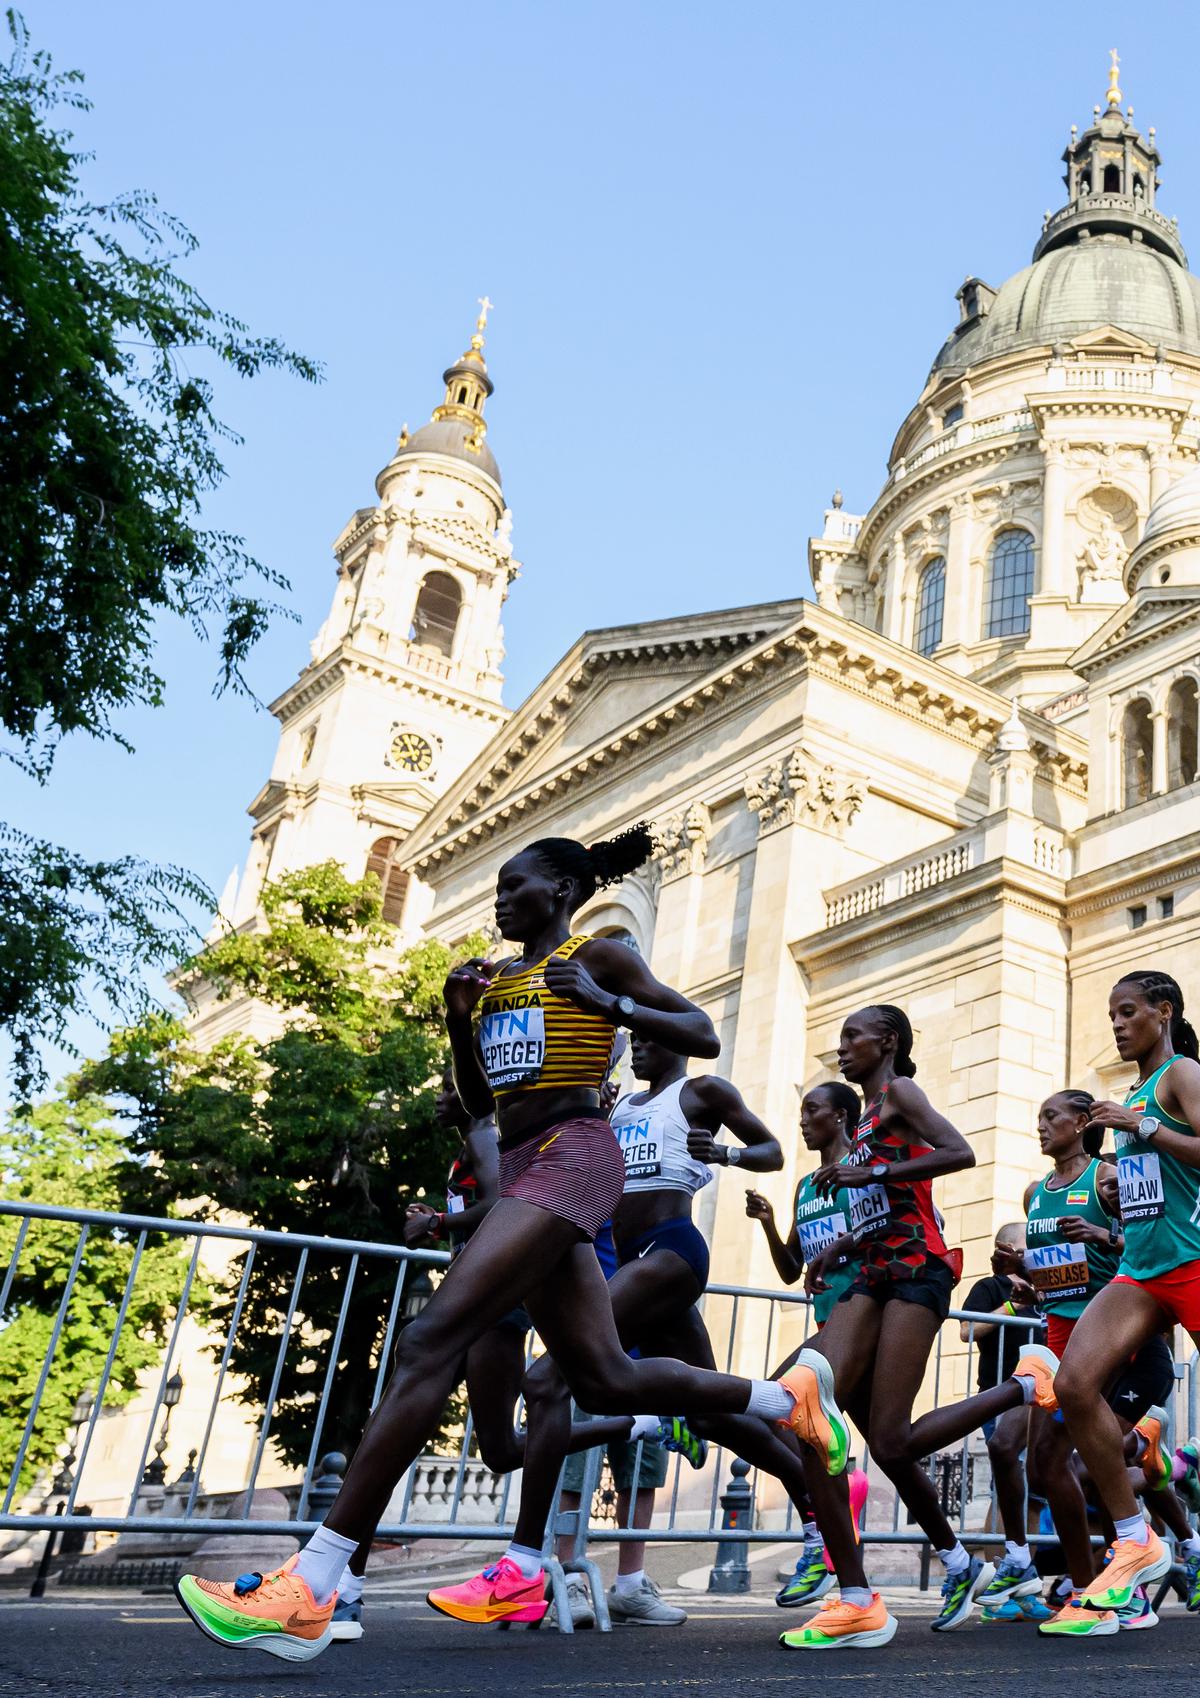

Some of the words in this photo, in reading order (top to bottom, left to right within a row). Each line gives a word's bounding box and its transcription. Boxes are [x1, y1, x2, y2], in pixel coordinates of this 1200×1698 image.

[482, 993, 541, 1015] GANDA
[480, 1010, 530, 1041] NTN
[484, 1041, 543, 1071] EPTEGEI
[622, 1143, 658, 1163] ETER
[626, 1166, 646, 1176] PEST
[646, 1165, 656, 1173] 23
[1149, 1207, 1158, 1215] 23
[800, 1217, 834, 1241] NTN
[878, 1218, 887, 1227] 23
[839, 1255, 847, 1263] 23
[1033, 1244, 1073, 1266] NTN
[1046, 1288, 1078, 1299] BUDAPEST
[1078, 1286, 1086, 1294] 23
